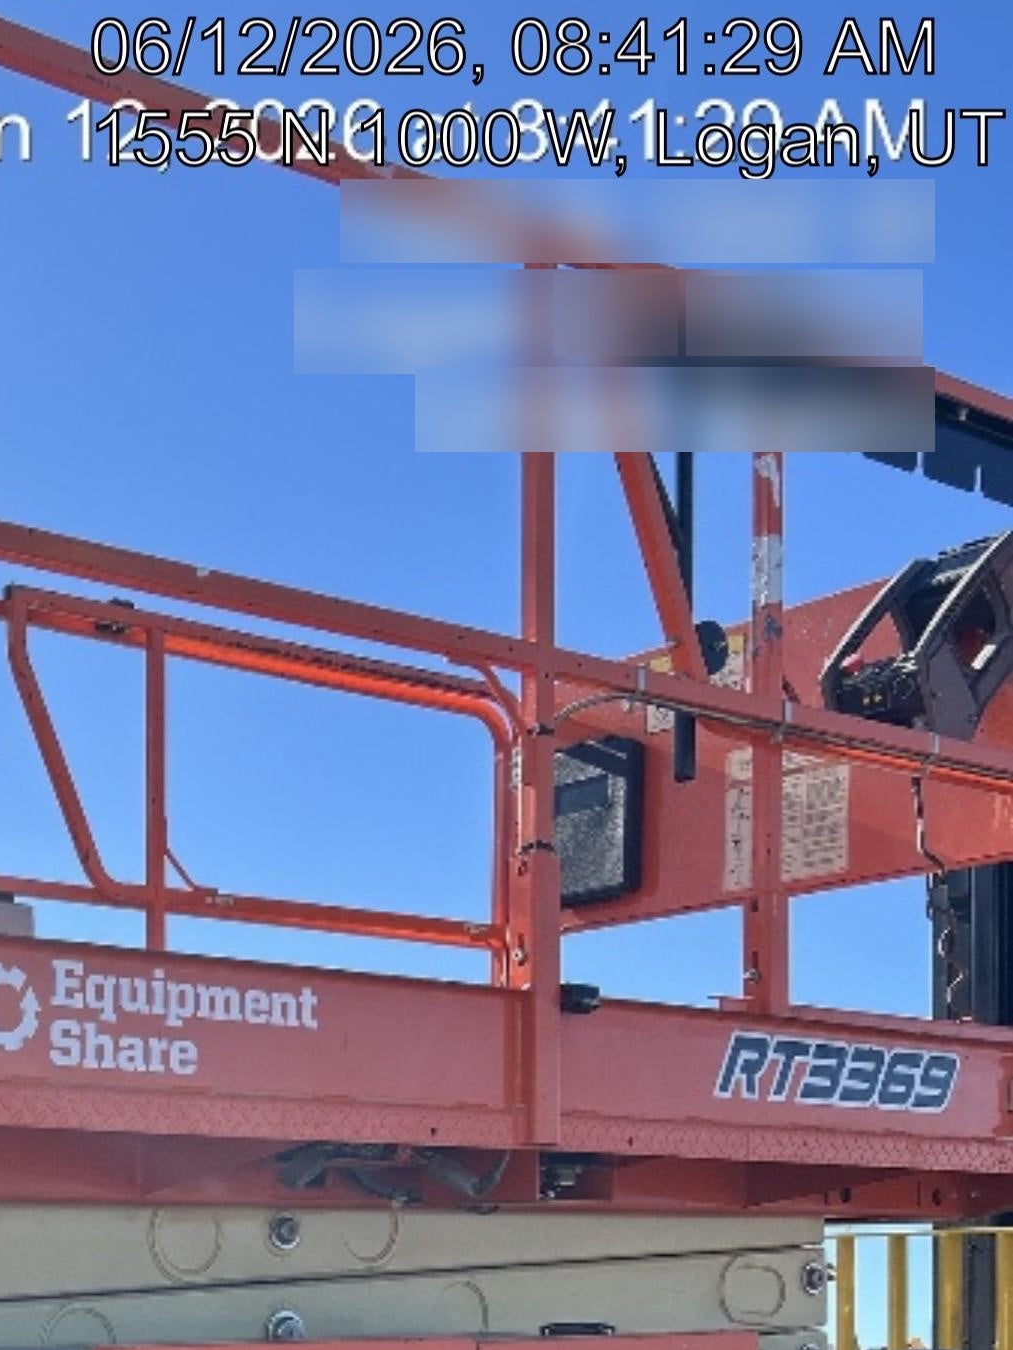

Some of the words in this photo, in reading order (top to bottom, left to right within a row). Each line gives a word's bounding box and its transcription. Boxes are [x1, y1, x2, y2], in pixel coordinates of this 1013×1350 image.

[51, 959, 318, 1029] Equipment
[49, 1019, 199, 1075] Share
[713, 1031, 961, 1113] RT3369
